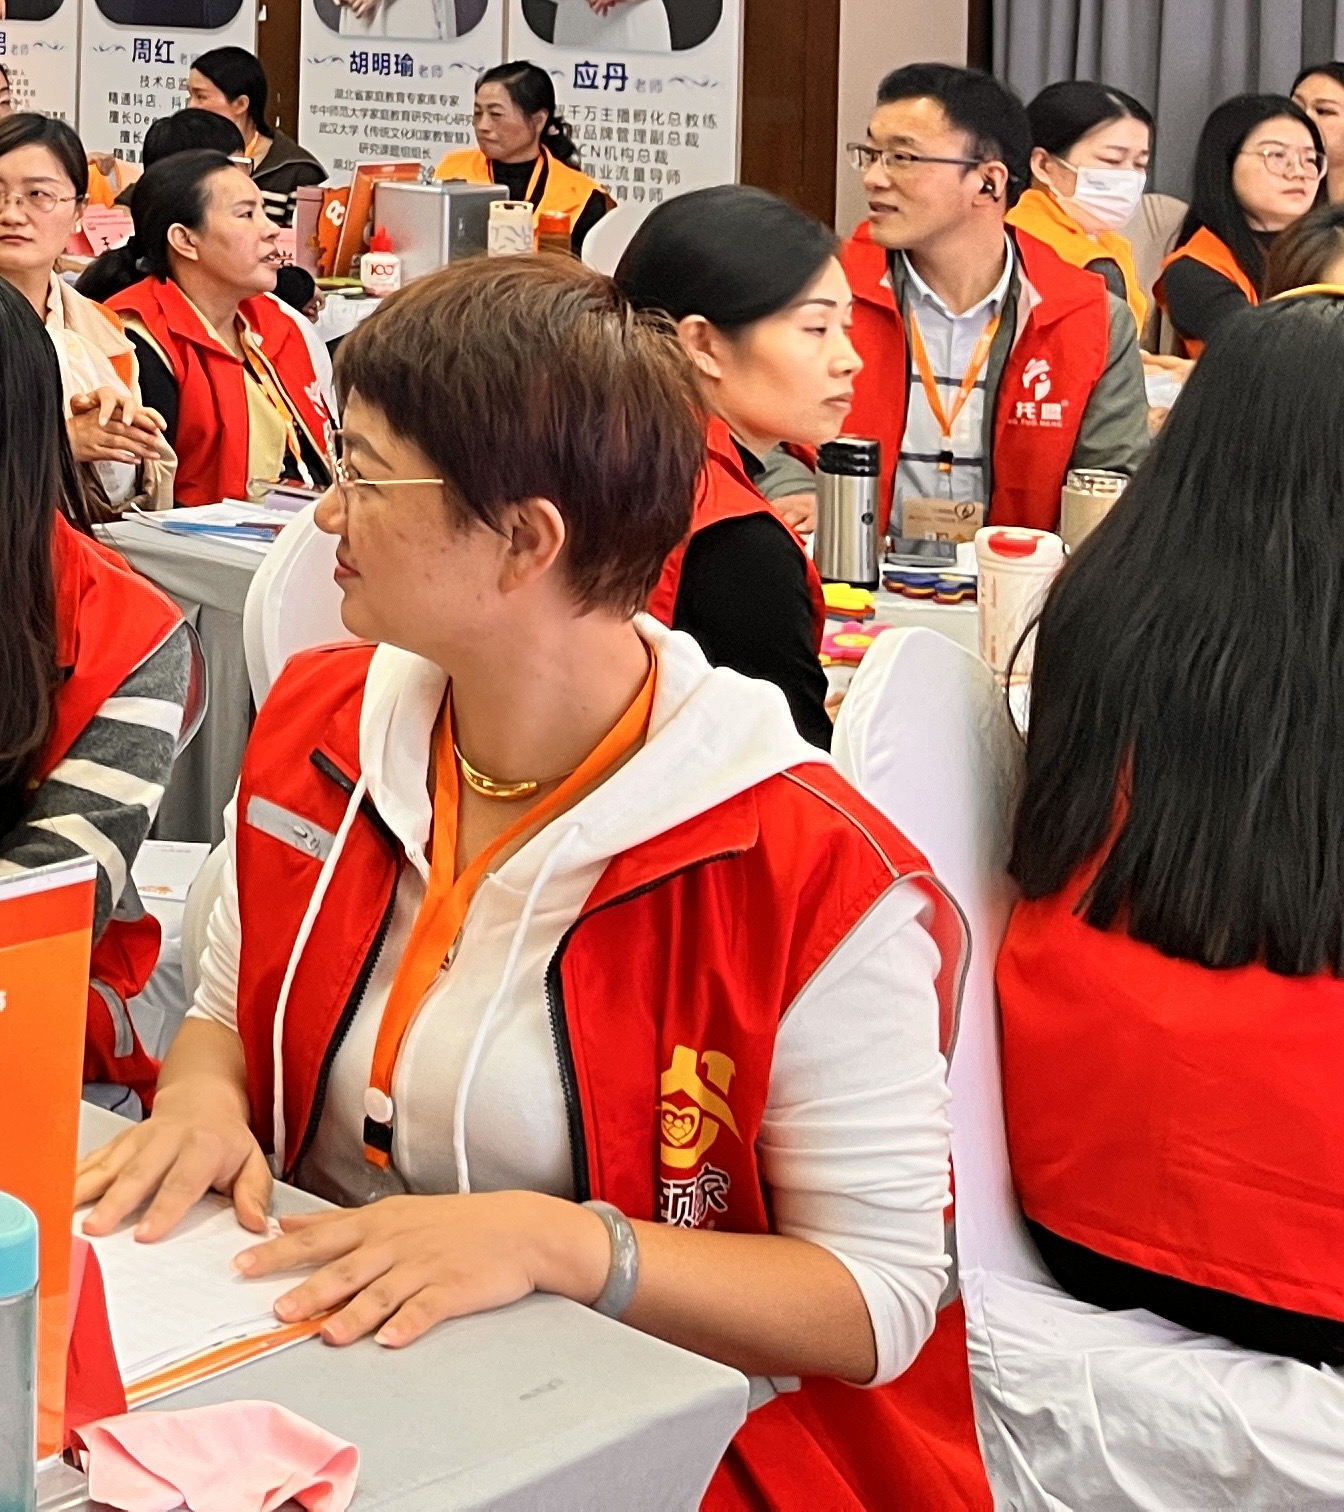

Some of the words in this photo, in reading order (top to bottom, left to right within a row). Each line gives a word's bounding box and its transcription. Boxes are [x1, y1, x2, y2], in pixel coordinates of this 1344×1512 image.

[132, 38, 175, 64] 周红
[349, 50, 414, 78] 胡明瑜
[572, 60, 629, 92] 应丹
